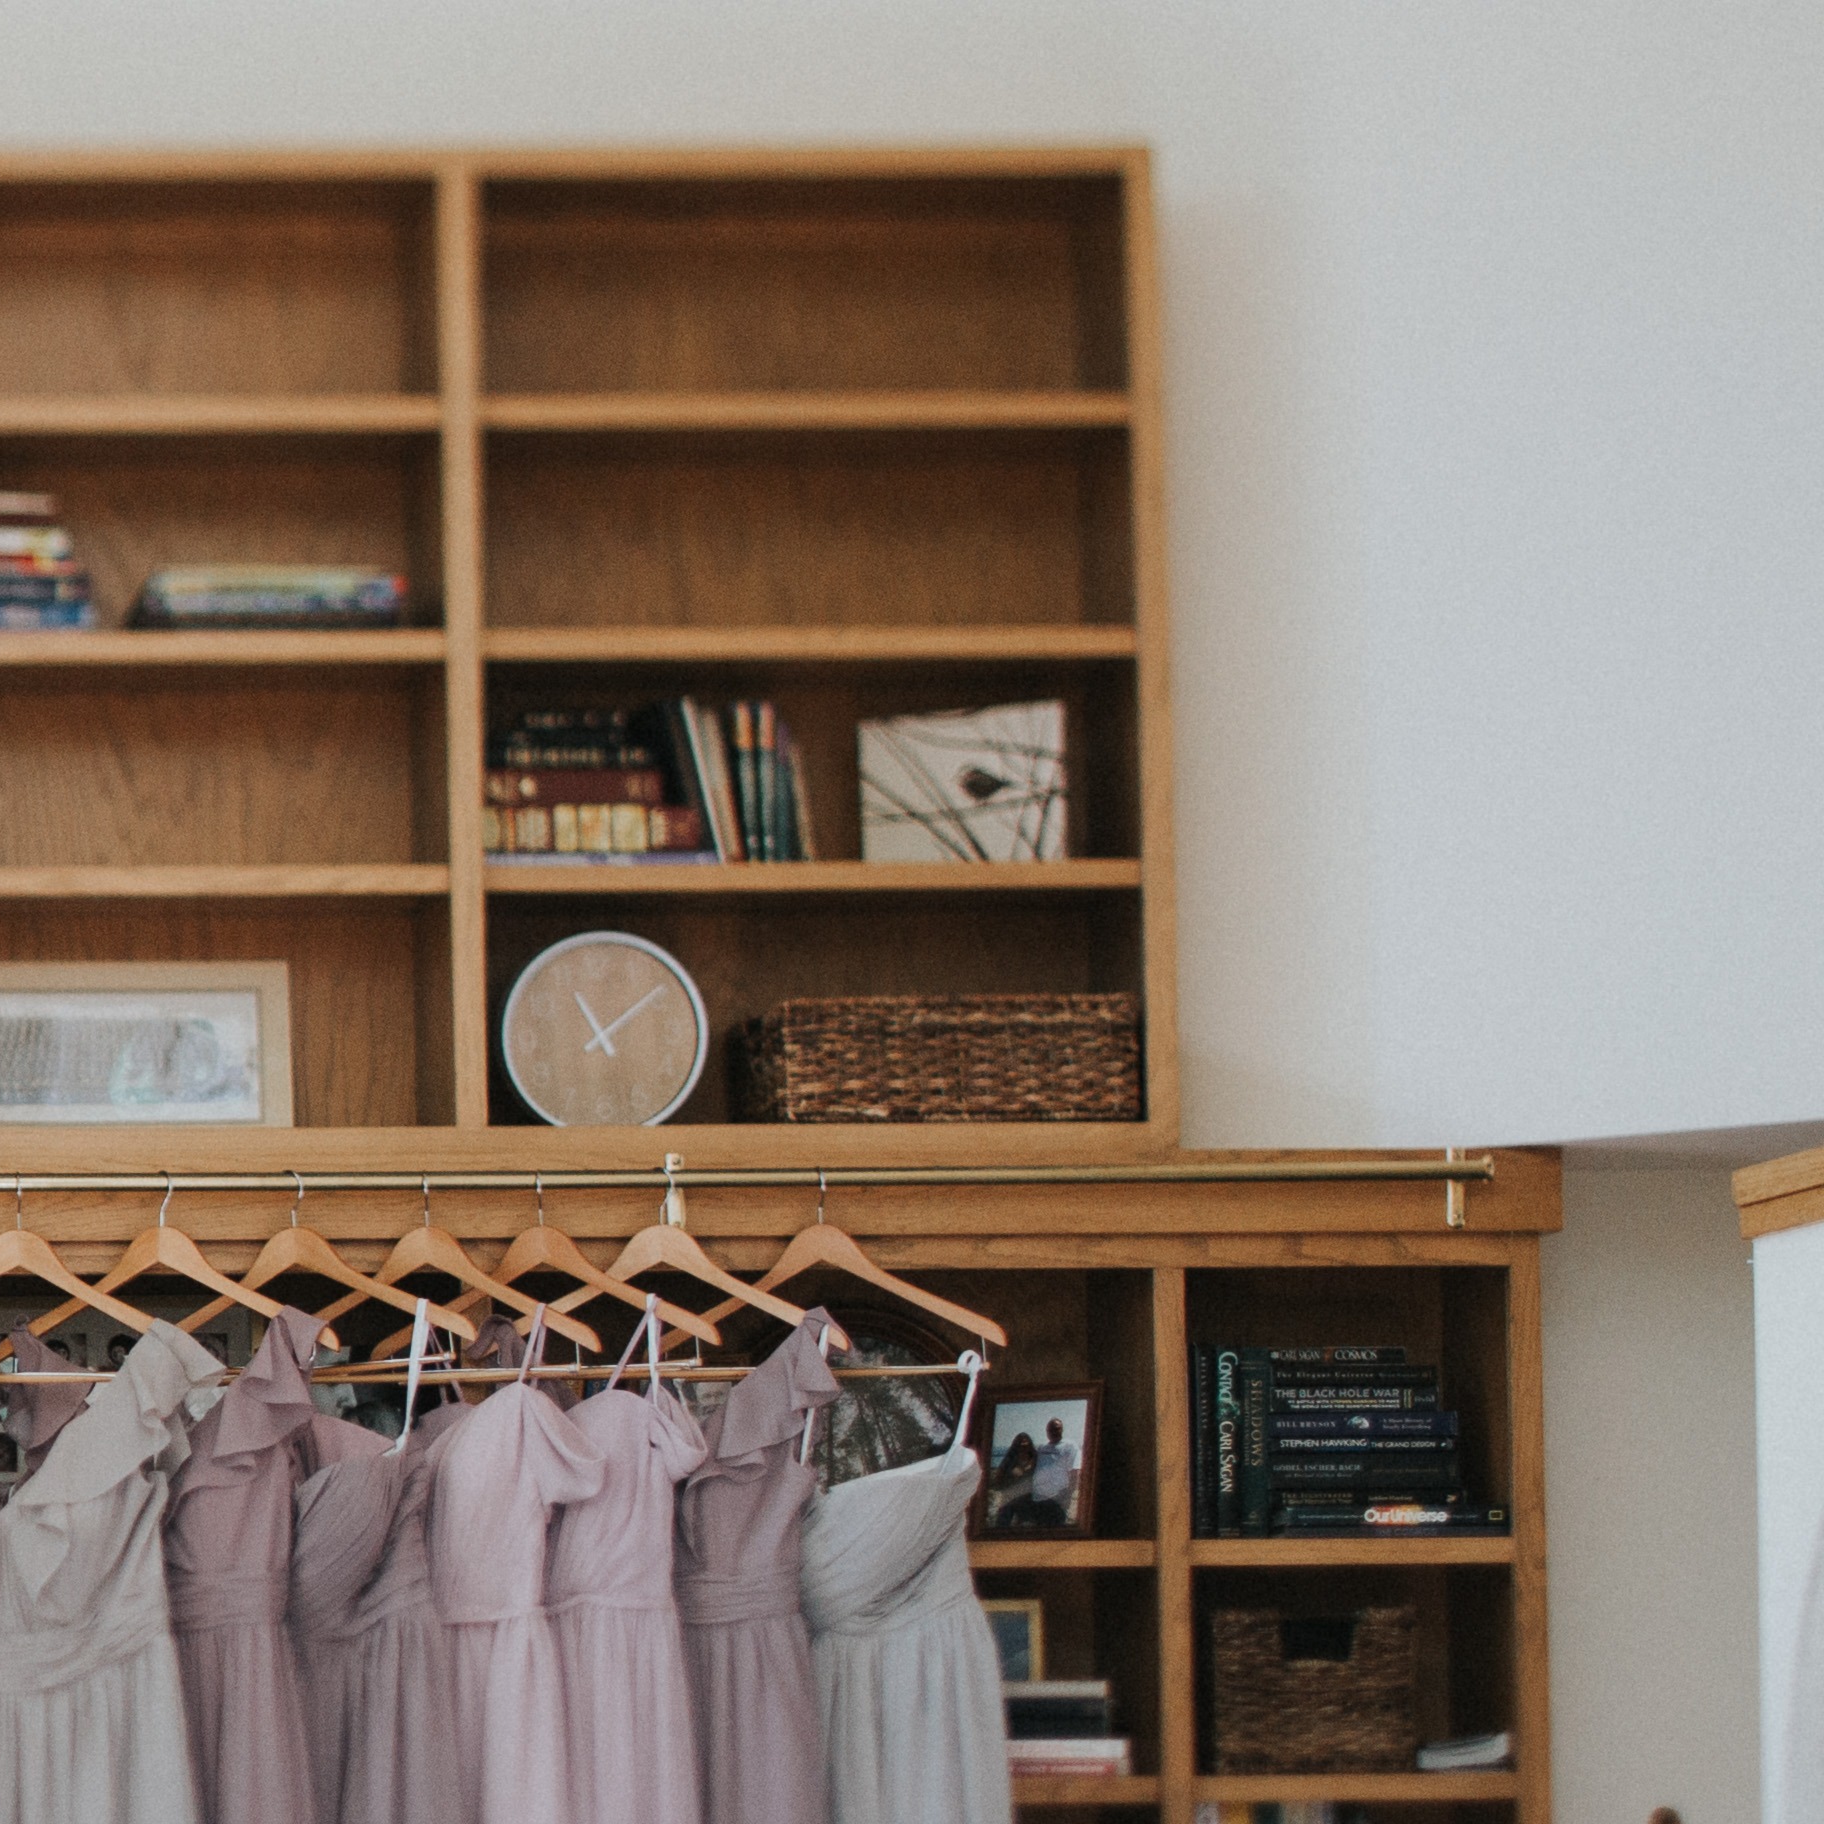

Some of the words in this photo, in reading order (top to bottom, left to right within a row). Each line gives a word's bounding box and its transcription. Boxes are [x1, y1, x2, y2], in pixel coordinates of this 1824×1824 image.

[1279, 1351, 1297, 1361] CARL
[1299, 1351, 1321, 1360] SAGAN
[1335, 1350, 1378, 1360] COSMOS
[1274, 1388, 1297, 1398] THE
[1298, 1388, 1336, 1398] BLACK
[1339, 1388, 1370, 1398] HOLE
[1373, 1388, 1400, 1398] WAR
[1251, 1379, 1263, 1467] SHADOWS
[1219, 1421, 1235, 1450] CARL
[1279, 1438, 1319, 1448] STEPHEN
[1321, 1438, 1367, 1448] HAWKING
[1219, 1454, 1236, 1493] SAGAN
